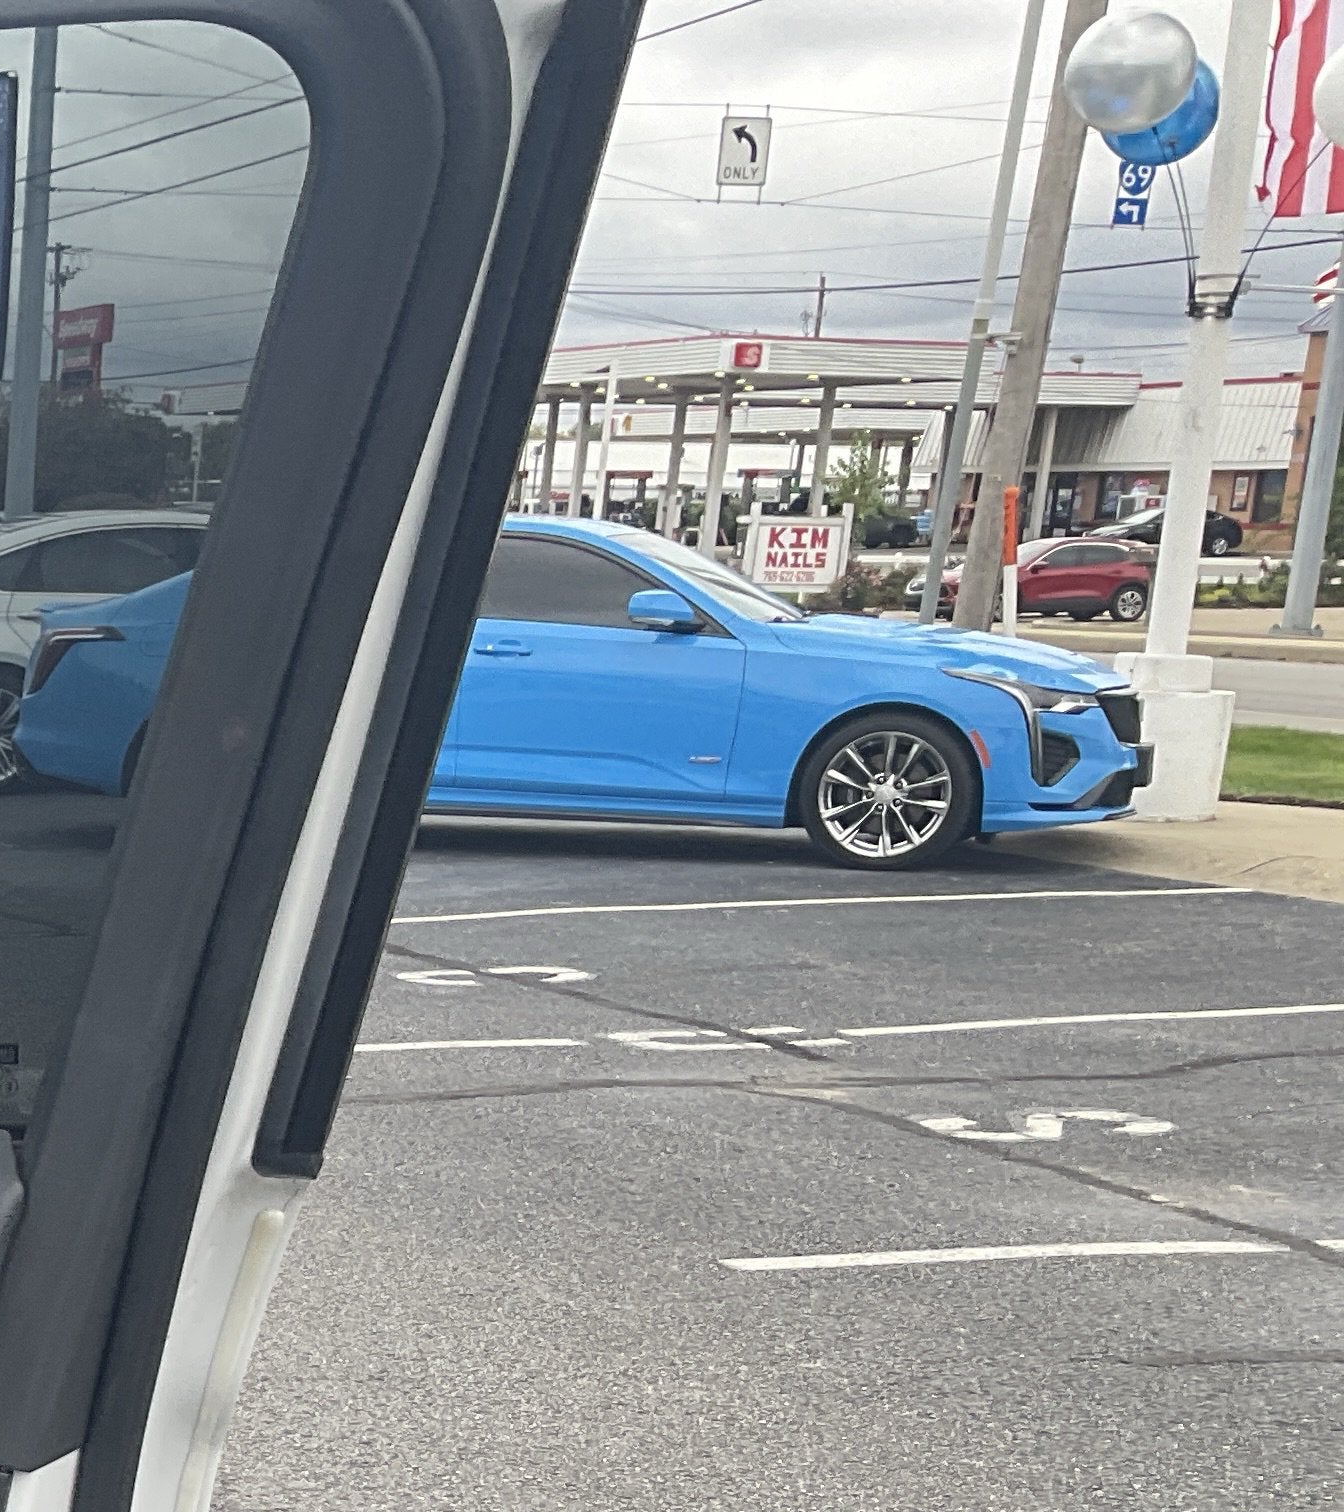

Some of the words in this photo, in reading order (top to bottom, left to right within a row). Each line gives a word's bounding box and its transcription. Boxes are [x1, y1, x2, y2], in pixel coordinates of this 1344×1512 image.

[723, 166, 759, 180] ONLY
[1122, 163, 1152, 189] 69
[768, 527, 830, 549] KIM
[765, 551, 827, 568] NAILS
